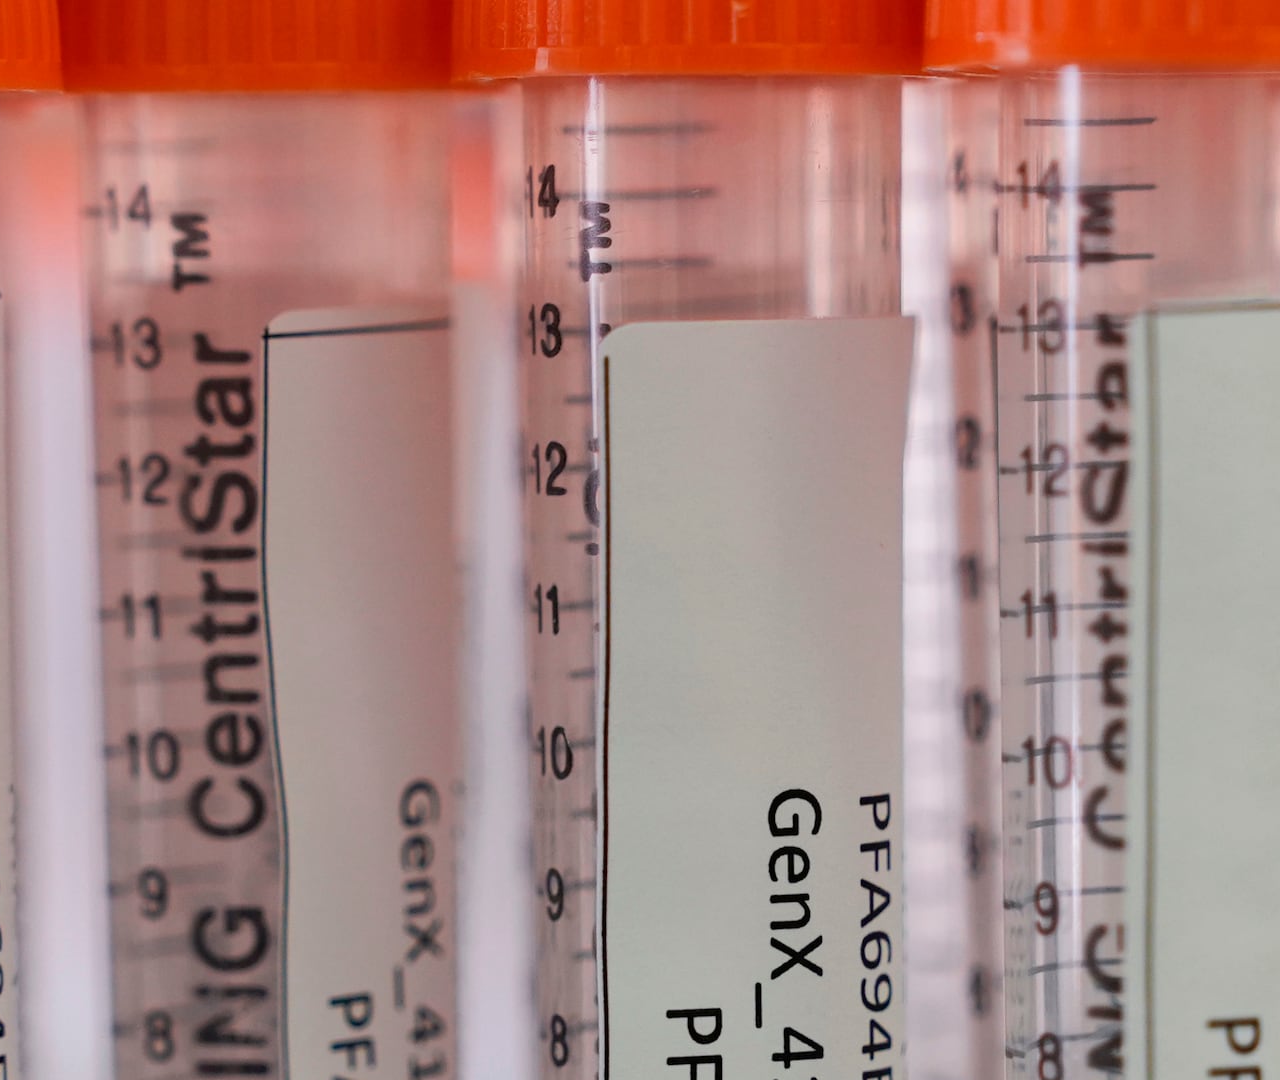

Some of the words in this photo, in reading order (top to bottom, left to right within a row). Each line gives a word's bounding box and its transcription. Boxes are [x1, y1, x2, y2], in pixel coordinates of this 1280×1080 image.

[106, 184, 152, 233] 14
[525, 164, 558, 219] 14
[1017, 159, 1060, 209] 14
[113, 317, 162, 370] 13
[528, 303, 562, 358] 13
[1020, 300, 1065, 354] 13
[117, 453, 173, 507] 12
[533, 441, 567, 496] 12
[1021, 444, 1069, 496] 12
[179, 332, 266, 839] CentriStar
[535, 581, 559, 634] 11
[120, 592, 162, 640] 11
[1023, 589, 1059, 638] 11
[124, 730, 180, 782] 10
[537, 725, 573, 780] 10
[1023, 736, 1074, 789] 10
[138, 870, 166, 920] 9
[546, 868, 565, 922] 9
[1033, 881, 1059, 935] 9
[144, 1009, 175, 1063] 8
[549, 1014, 568, 1067] 8
